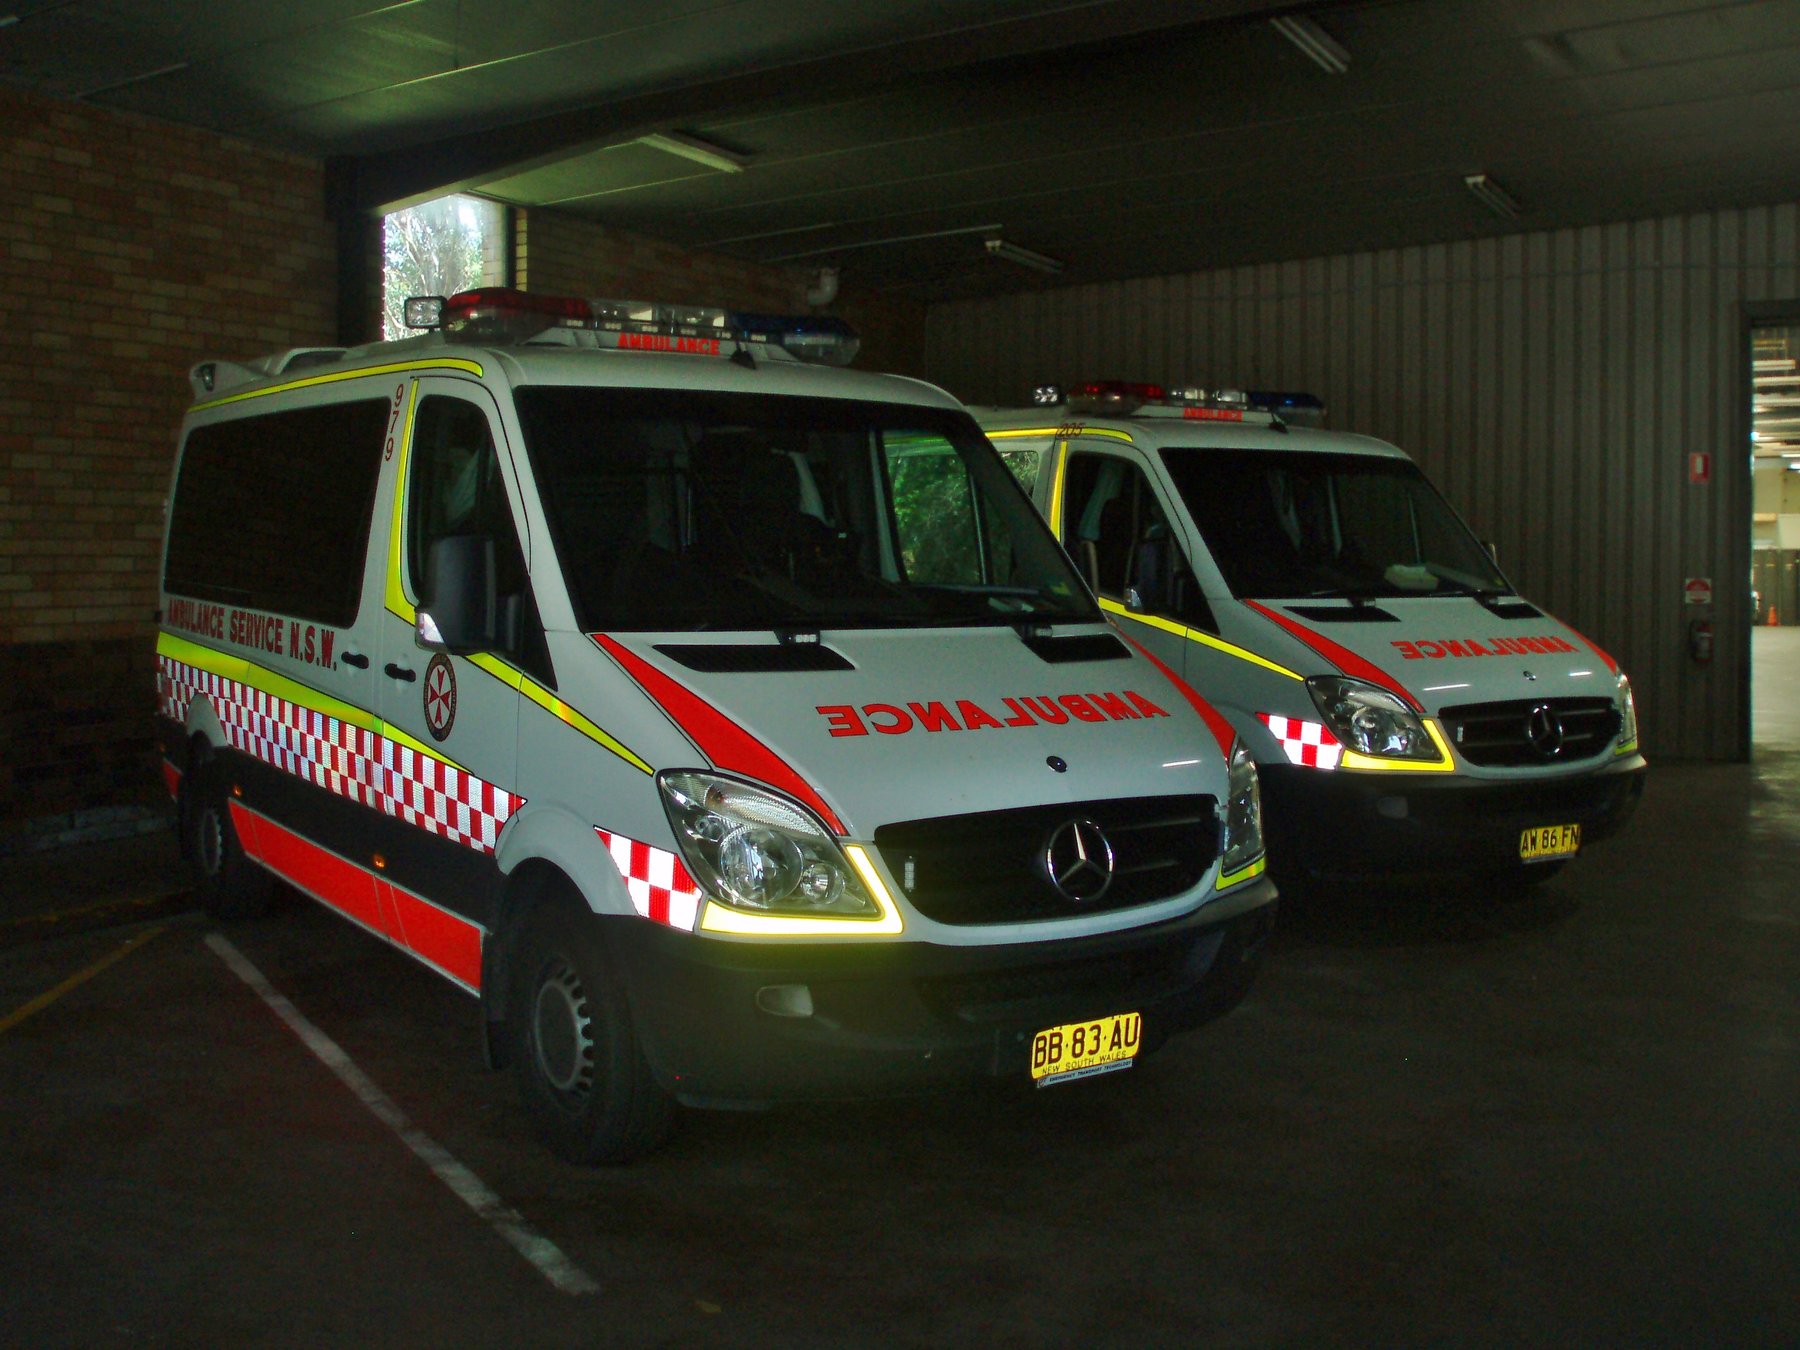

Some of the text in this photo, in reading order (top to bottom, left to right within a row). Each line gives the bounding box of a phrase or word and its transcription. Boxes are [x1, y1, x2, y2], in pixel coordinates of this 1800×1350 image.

[617, 331, 721, 356] AMBULANCE
[384, 383, 404, 462] 979
[169, 600, 338, 672] AMBULANCE SERVICE N.S.W.
[1042, 1050, 1127, 1076] NEW SOUTH WALES
